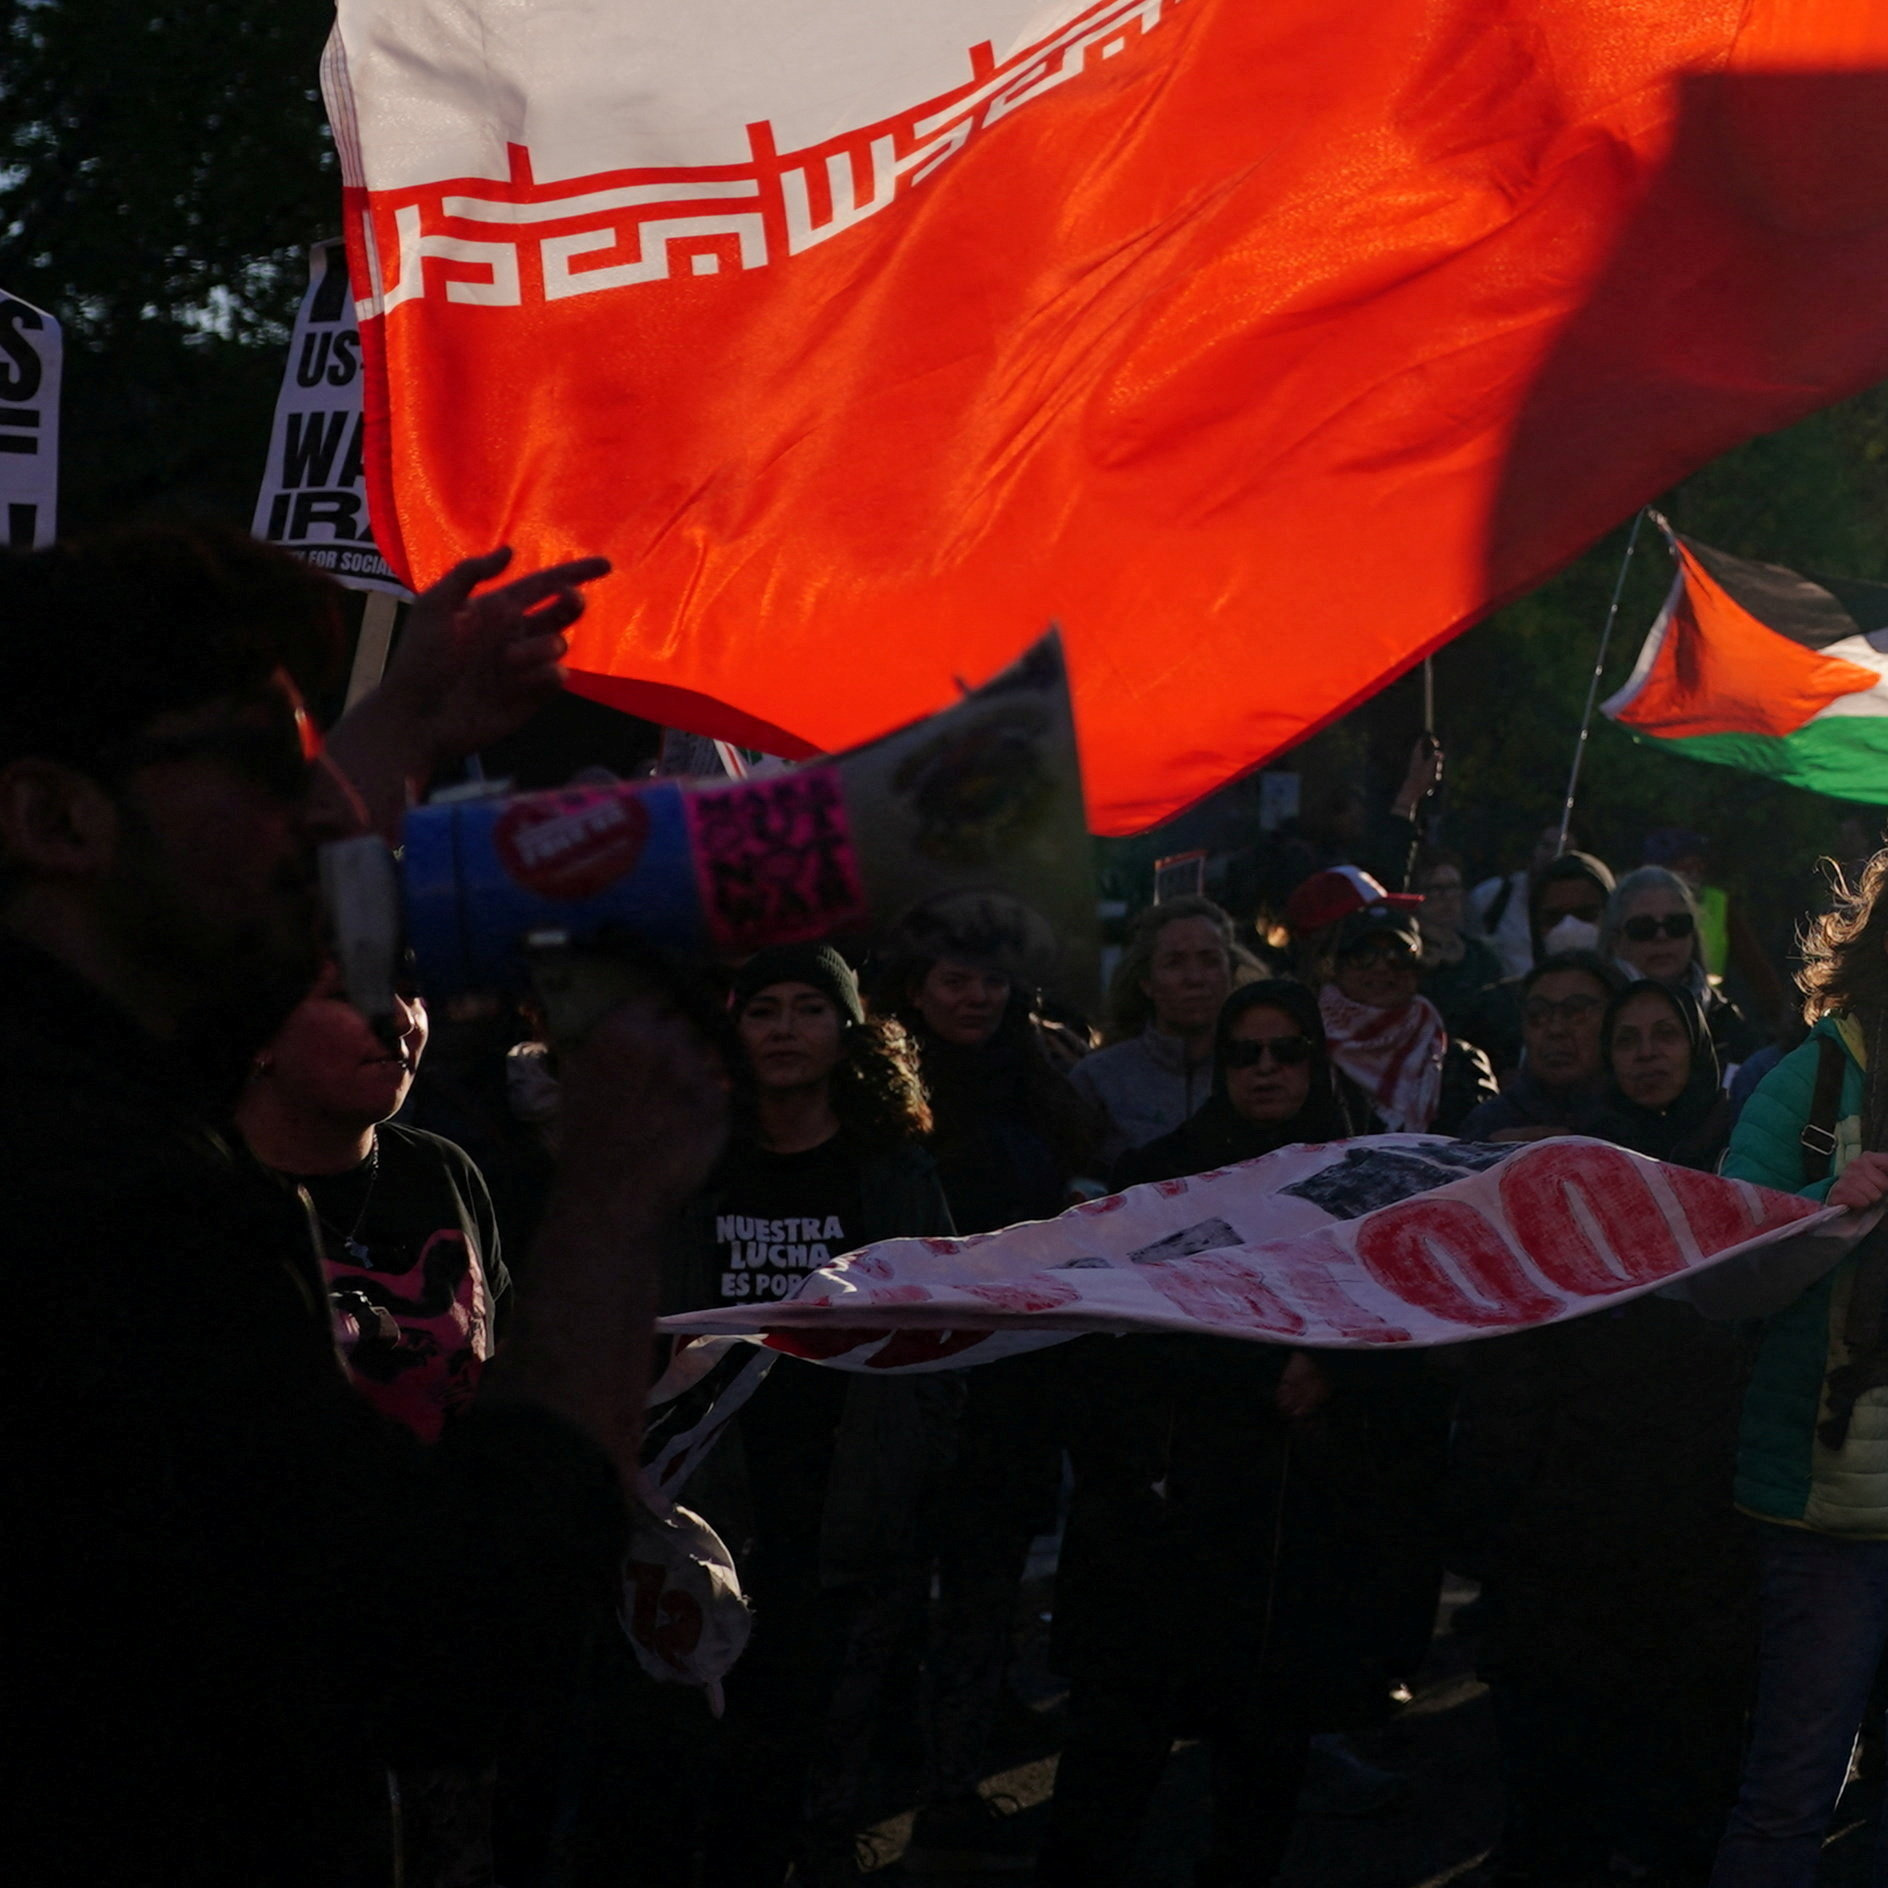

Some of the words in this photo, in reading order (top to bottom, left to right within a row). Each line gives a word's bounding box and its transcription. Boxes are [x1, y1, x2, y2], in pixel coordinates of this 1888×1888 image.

[298, 329, 360, 388] US
[716, 1214, 845, 1244] NUESTRA
[730, 1240, 831, 1270] LUCHA
[721, 1272, 750, 1297] ES
